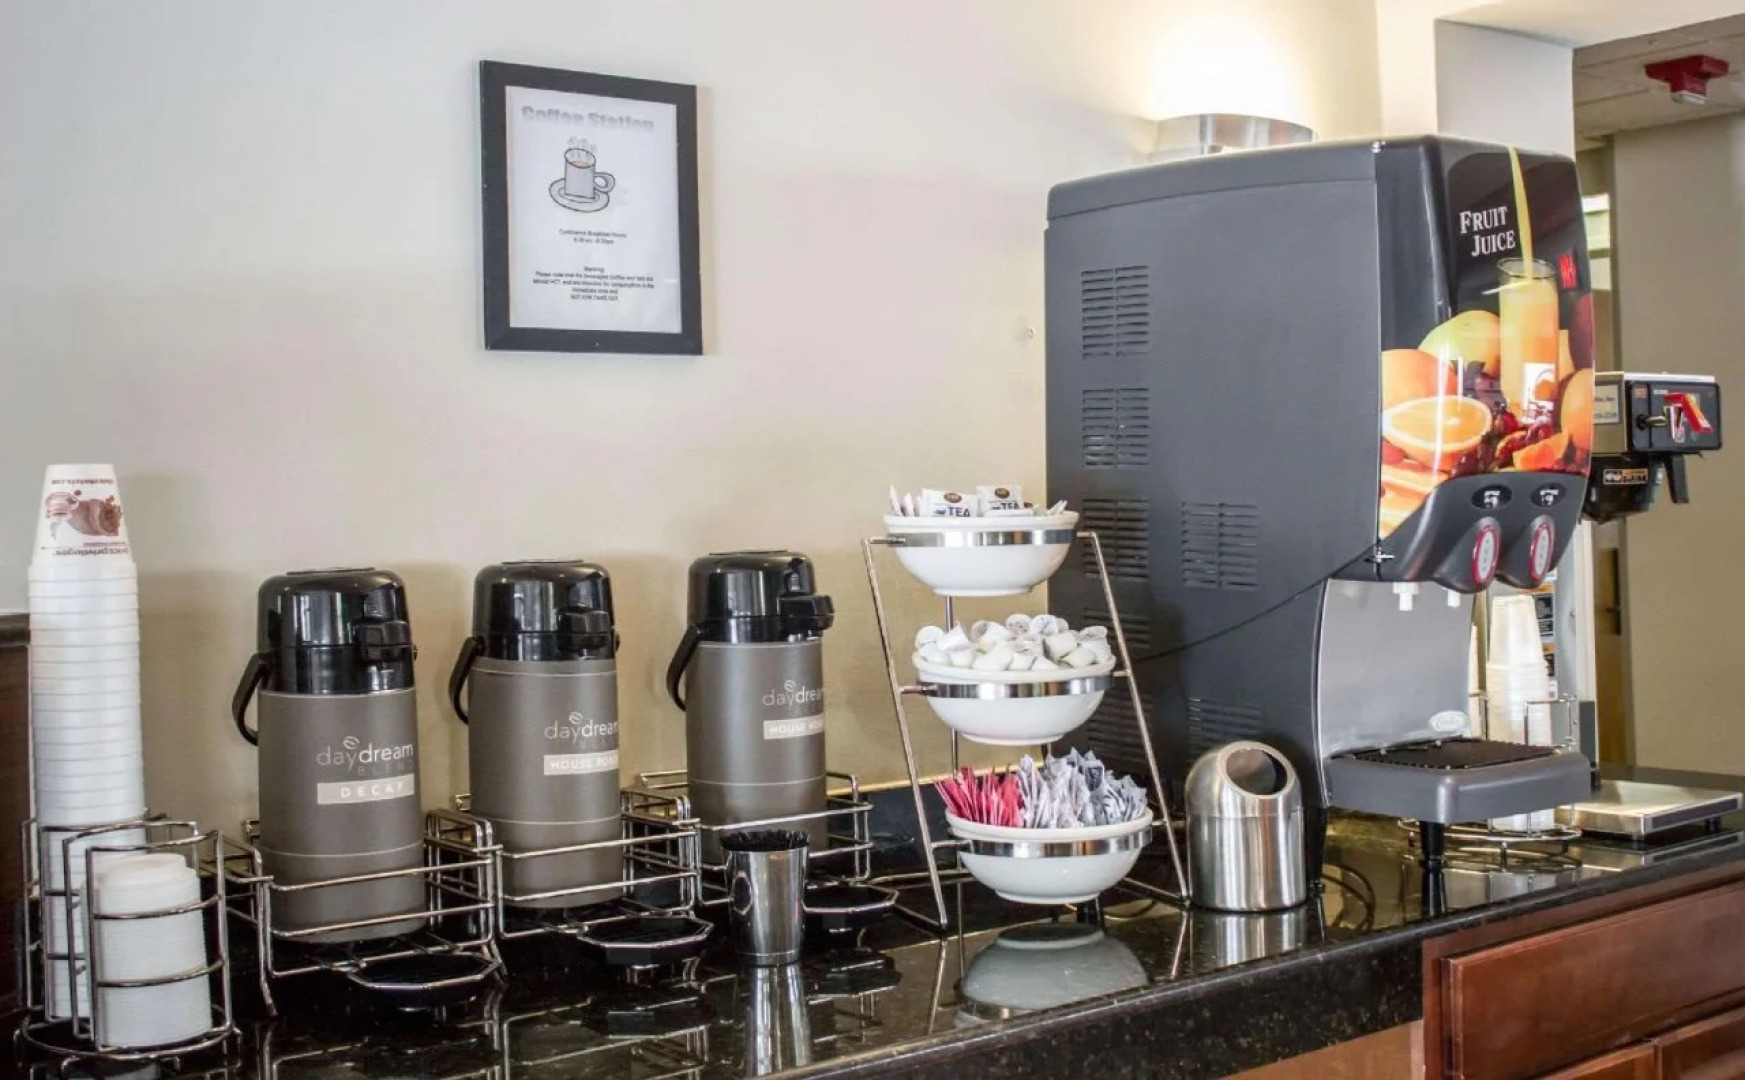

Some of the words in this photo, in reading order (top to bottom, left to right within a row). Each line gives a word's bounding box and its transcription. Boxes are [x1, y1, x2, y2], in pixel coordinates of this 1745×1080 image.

[521, 105, 584, 122] Coffee
[588, 112, 654, 131] Station
[948, 506, 970, 517] TEA
[316, 742, 414, 772] daydream
